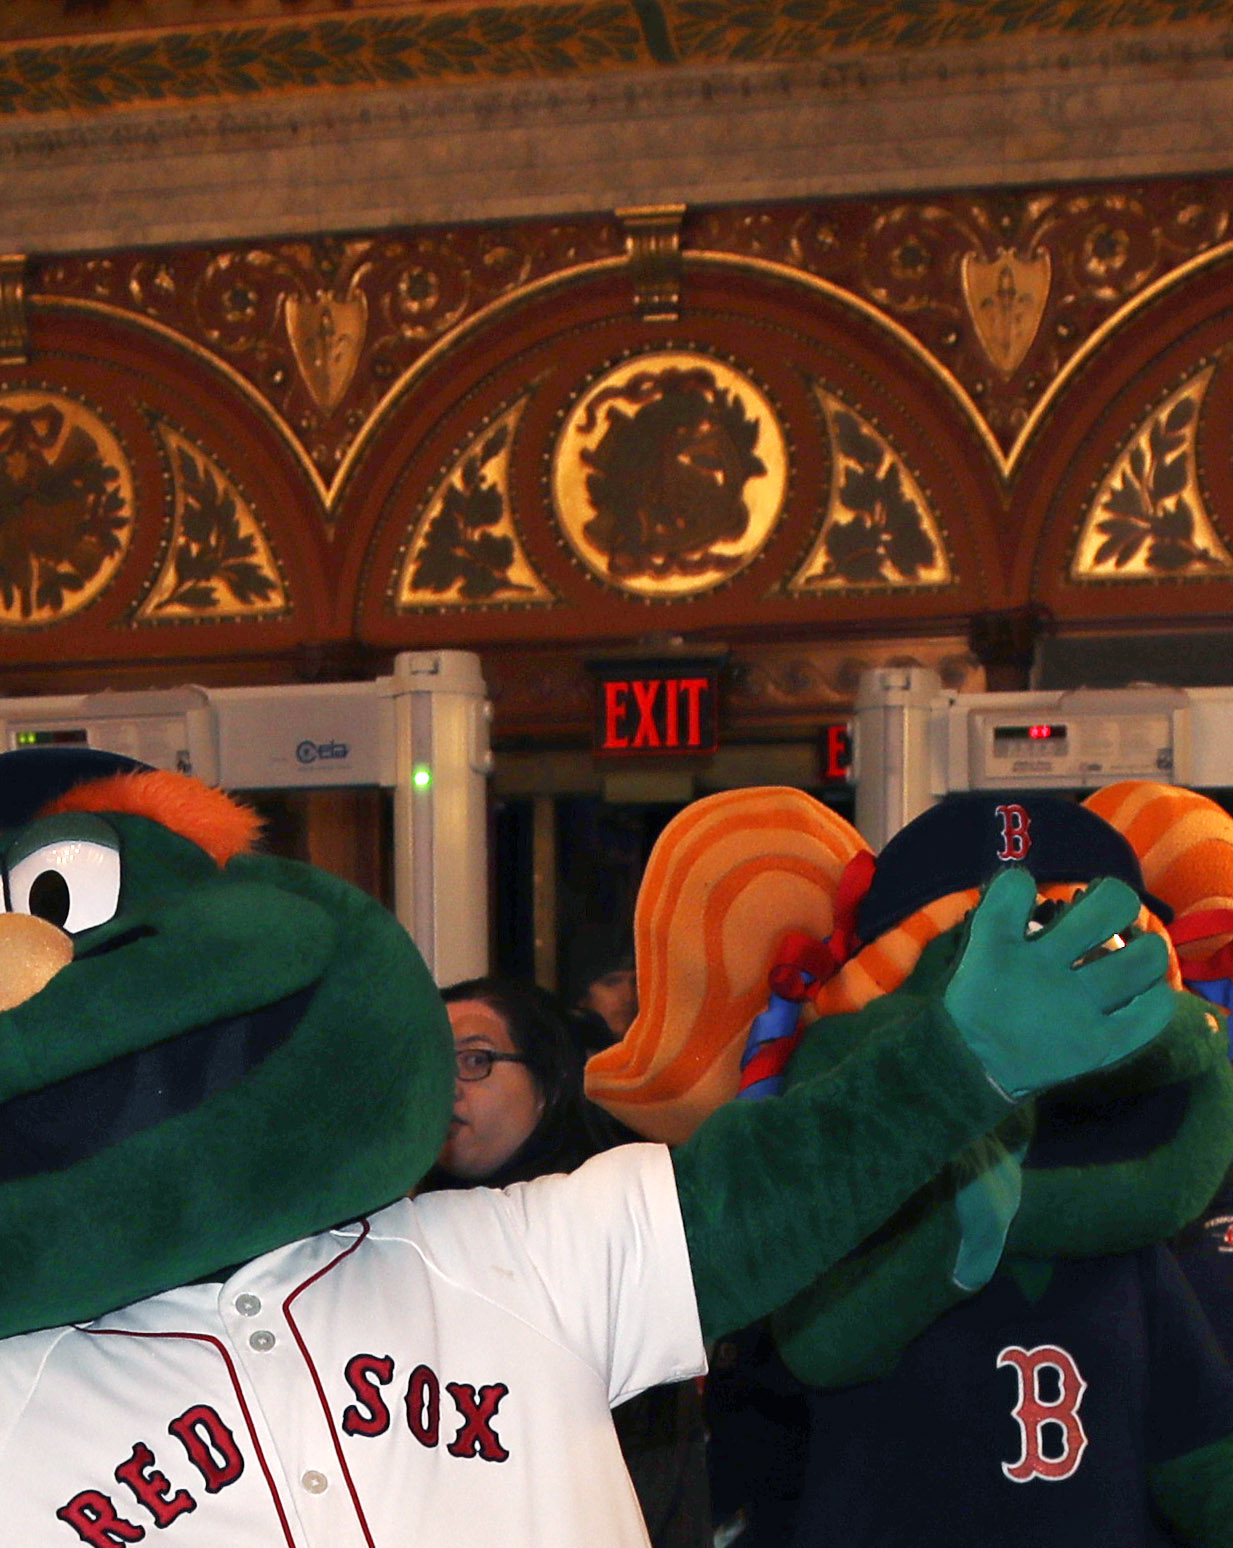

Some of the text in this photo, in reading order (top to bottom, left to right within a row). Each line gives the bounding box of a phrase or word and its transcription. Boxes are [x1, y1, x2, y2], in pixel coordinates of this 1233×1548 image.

[604, 677, 709, 748] EXIT
[995, 804, 1032, 861] B
[342, 1353, 510, 1462] SOX
[996, 1344, 1088, 1483] B
